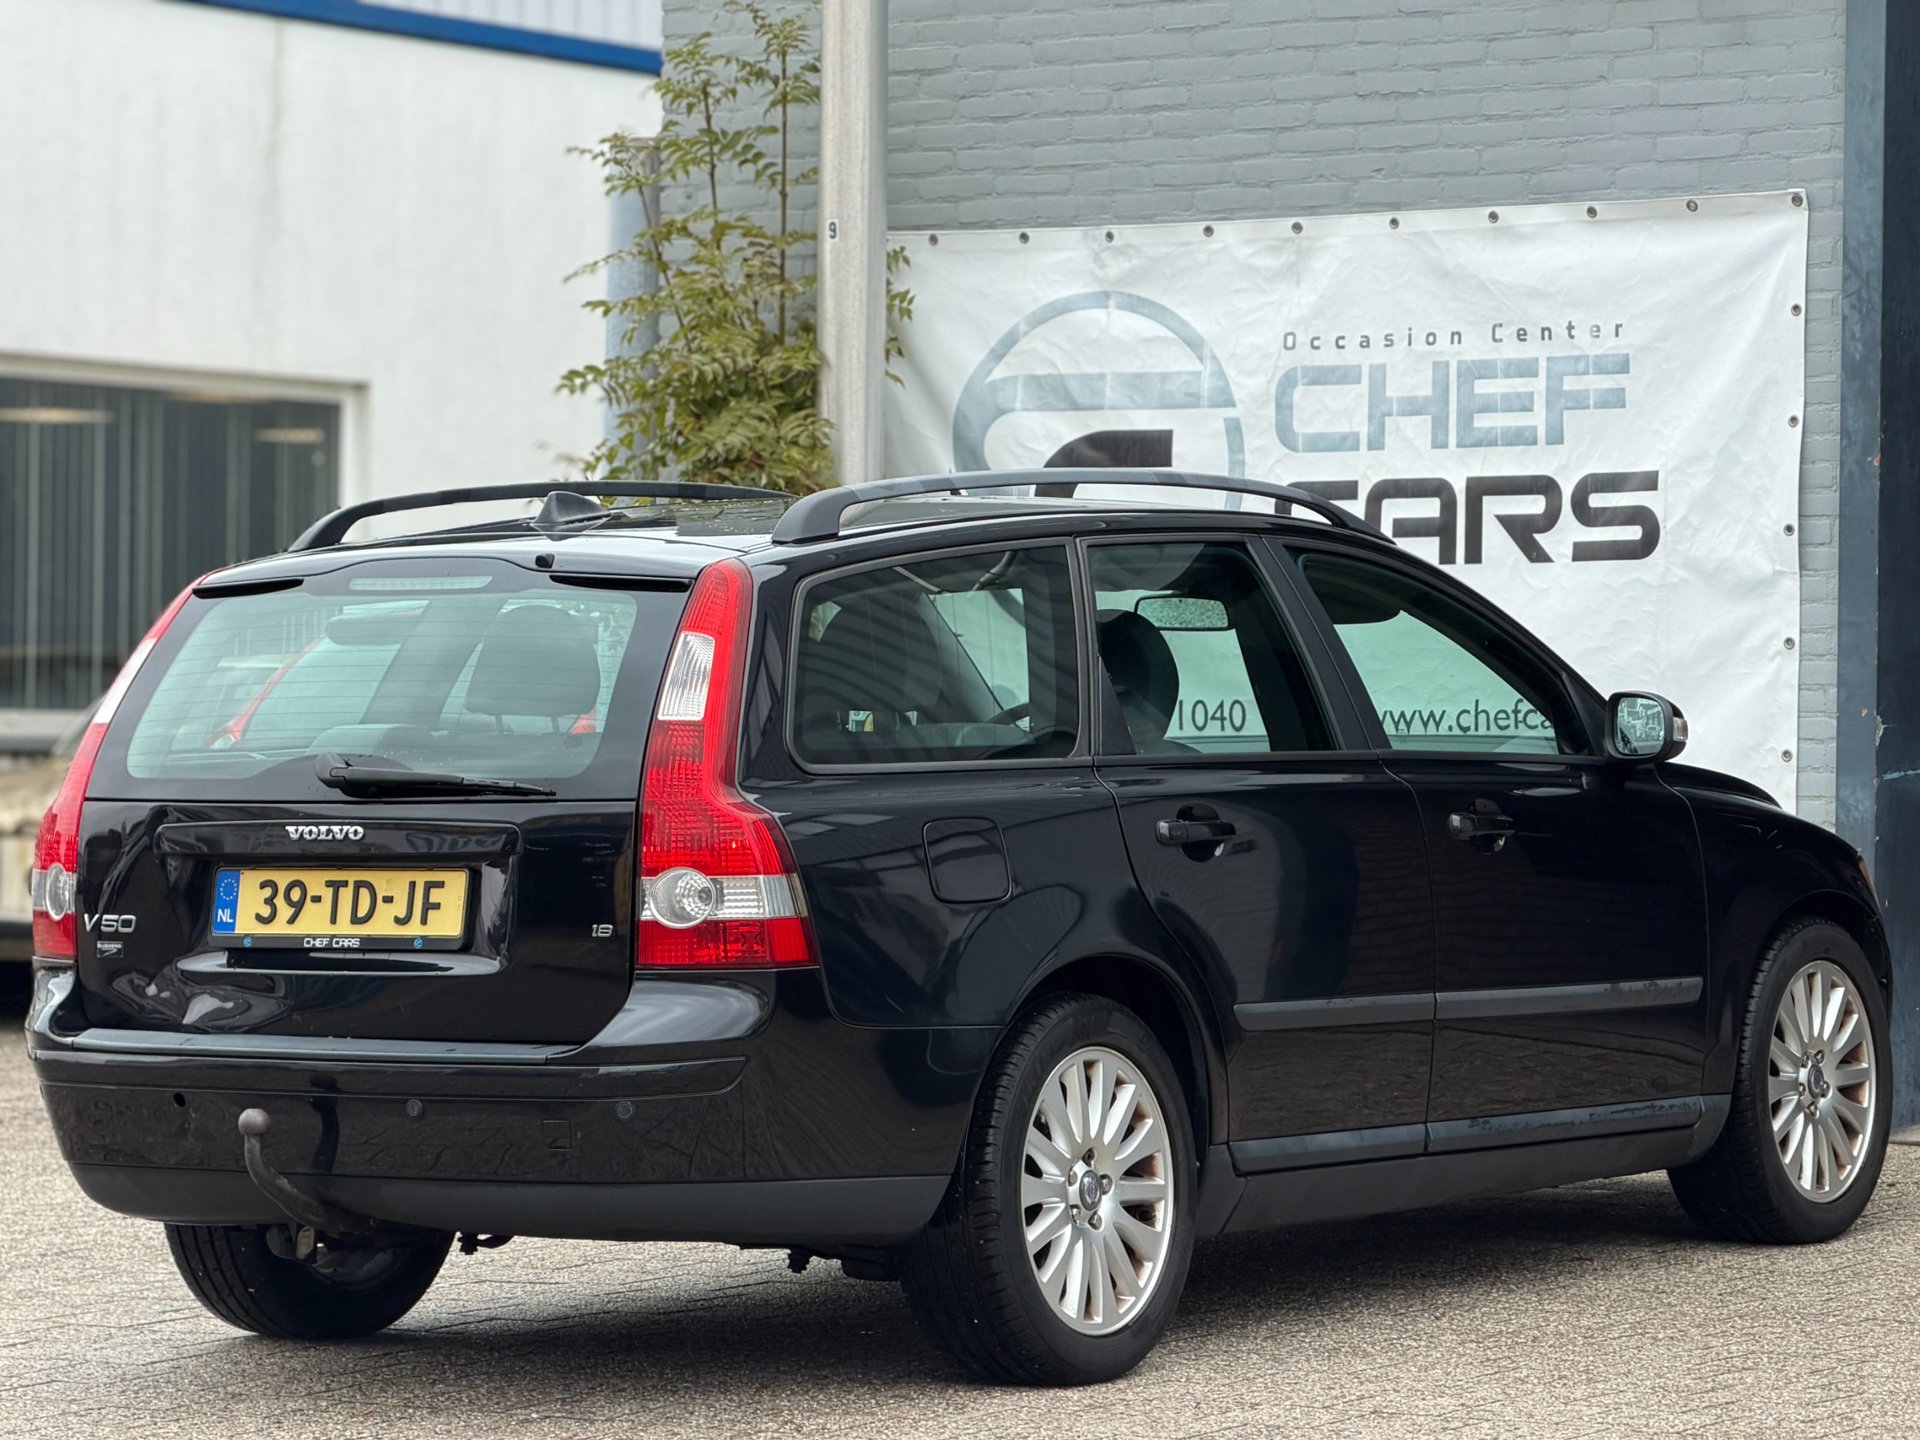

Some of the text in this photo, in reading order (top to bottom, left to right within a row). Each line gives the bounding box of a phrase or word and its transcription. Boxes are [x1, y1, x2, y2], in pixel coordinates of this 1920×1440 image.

[828, 221, 837, 239] 9
[1283, 320, 1623, 351] Occasion Center
[1274, 352, 1630, 453] CHEF
[1178, 698, 1247, 732] 1040
[285, 825, 364, 841] VOLVO
[254, 879, 445, 926] 39-TD-JF
[83, 913, 137, 933] V50
[217, 908, 234, 923] NL
[303, 937, 361, 948] CHEF CARS
